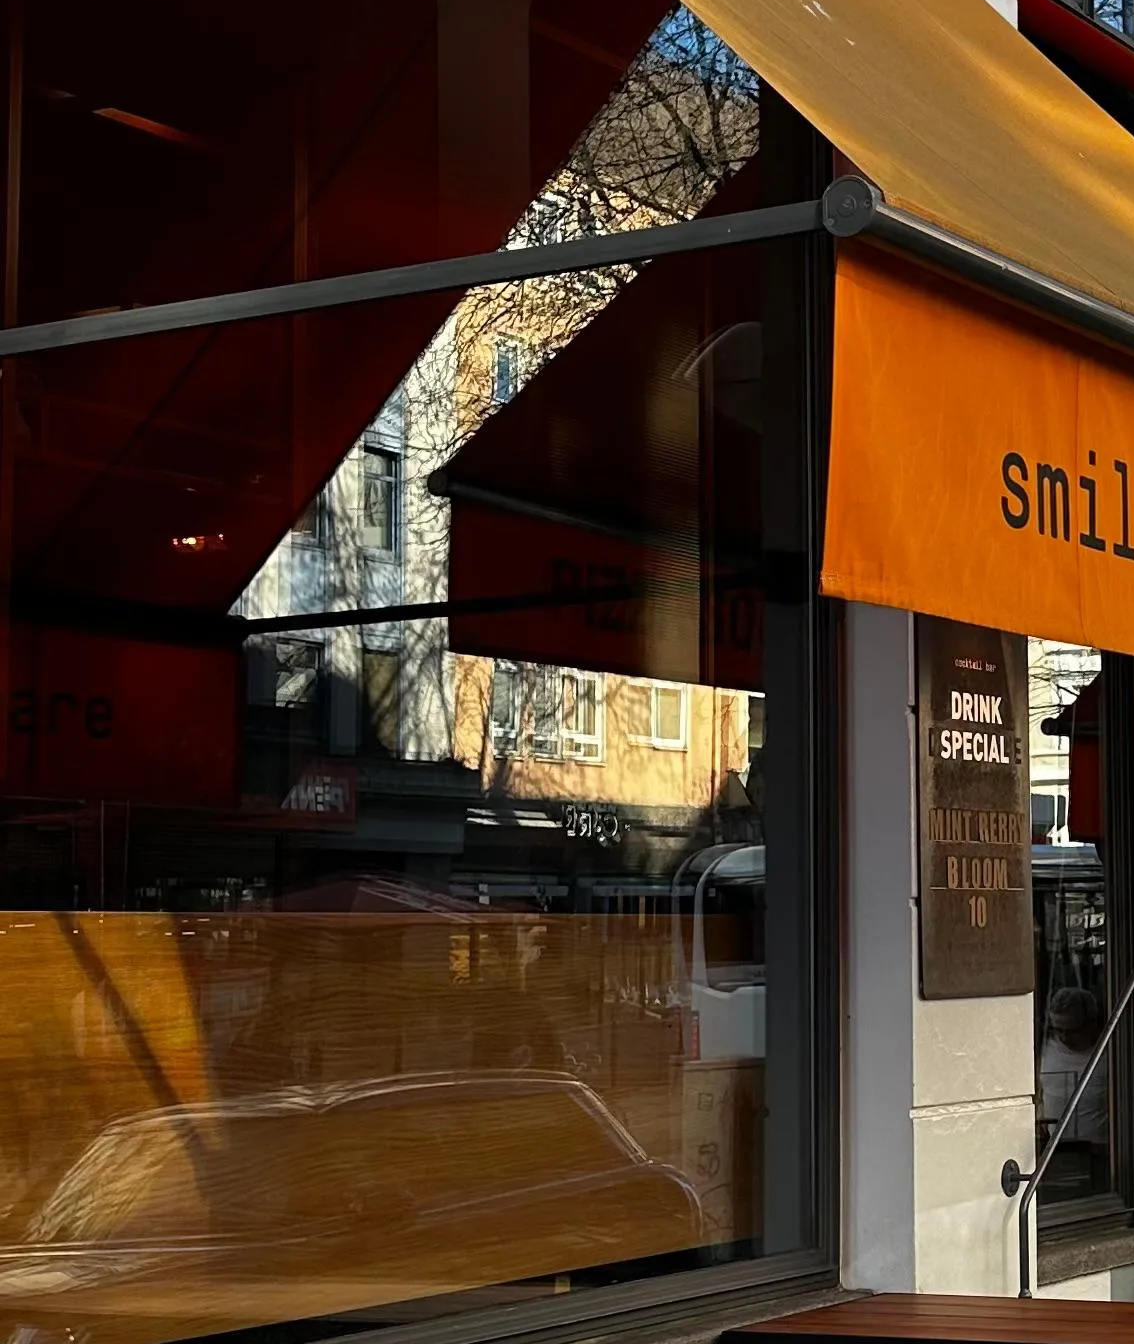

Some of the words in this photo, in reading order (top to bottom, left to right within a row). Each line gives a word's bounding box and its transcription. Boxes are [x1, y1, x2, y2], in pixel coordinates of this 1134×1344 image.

[951, 690, 1003, 725] DRINK
[940, 729, 1010, 764] SPECIAL
[929, 808, 972, 841] MINT
[947, 856, 1009, 890] BLOOM
[968, 895, 987, 928] 10
